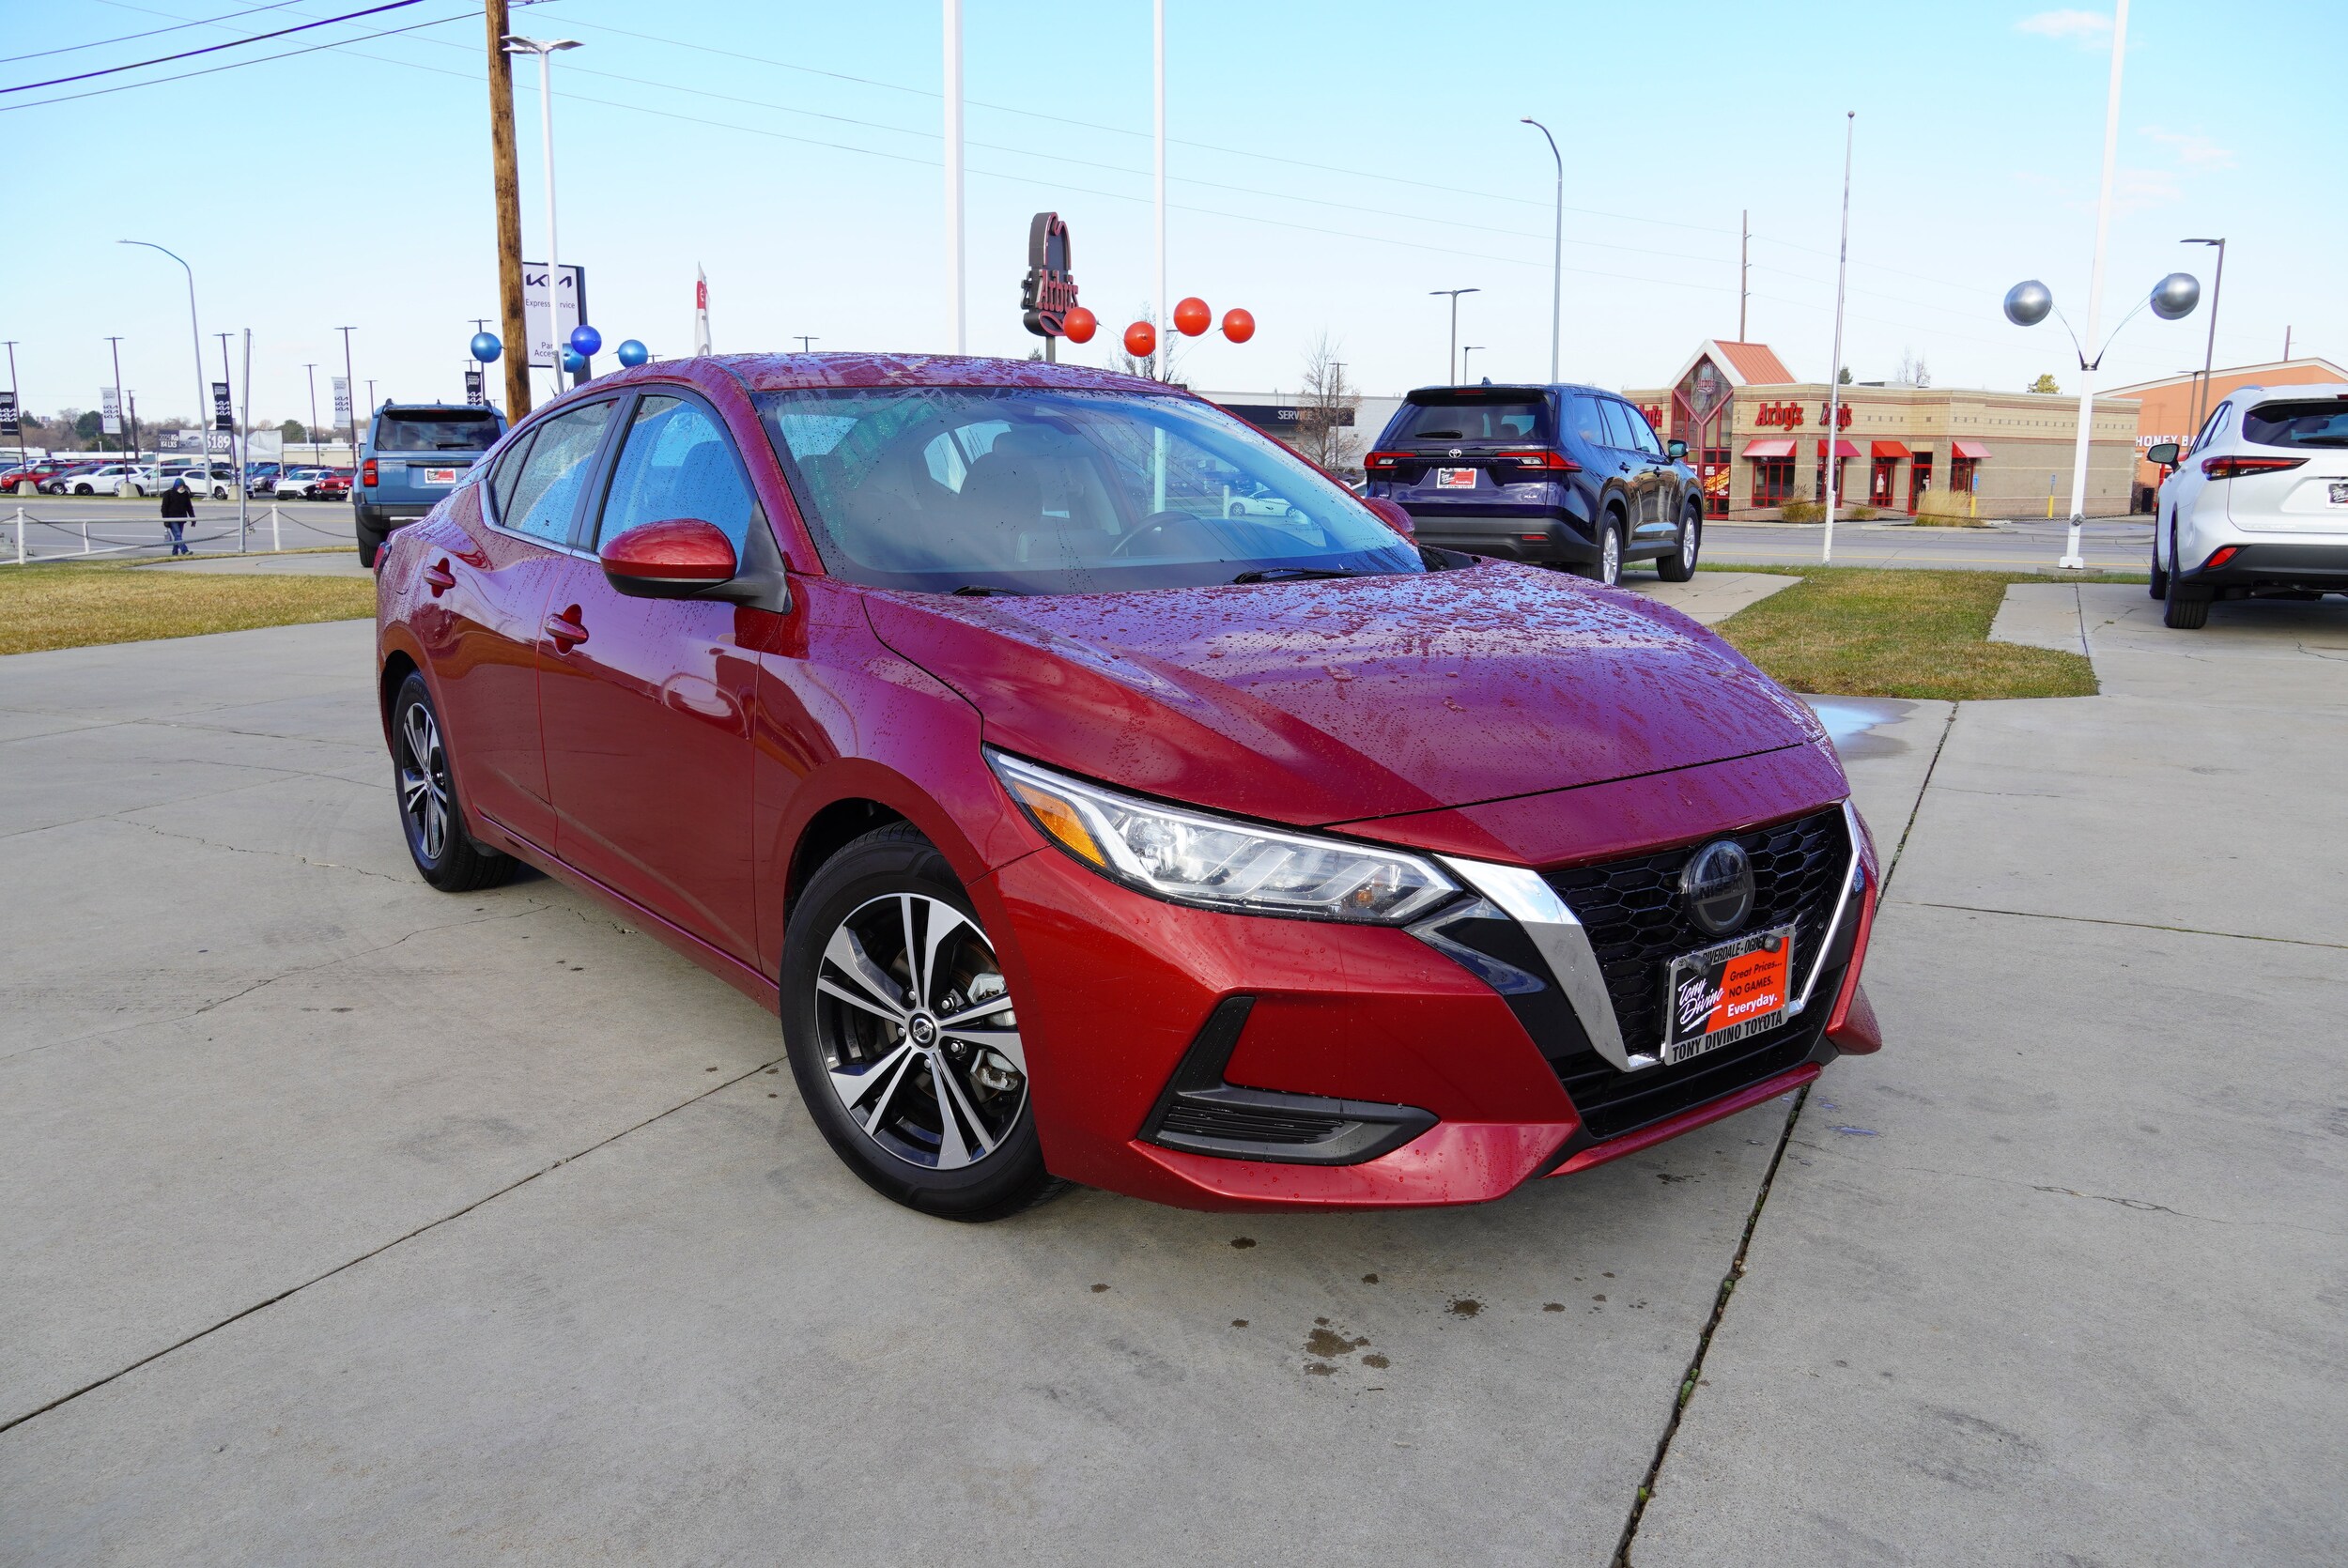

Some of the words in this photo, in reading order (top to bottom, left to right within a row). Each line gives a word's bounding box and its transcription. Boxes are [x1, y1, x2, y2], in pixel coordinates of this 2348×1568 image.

[526, 273, 572, 288] KA
[1035, 269, 1079, 314] Arby's
[1755, 401, 1804, 431] Arby's
[1819, 402, 1852, 432] Ay's
[207, 434, 231, 448] $189
[2135, 436, 2178, 446] HONEY
[1729, 986, 1742, 998] NO
[1744, 976, 1774, 993] GAMES.
[1730, 968, 1752, 982] Great
[1678, 975, 1707, 1007] Tony
[1727, 992, 1778, 1018] Everyday.
[1677, 988, 1724, 1025] Divino
[1673, 1039, 1701, 1062] TONY
[1705, 1024, 1742, 1051] DIVINO
[1745, 1010, 1783, 1034] TOYOTA
